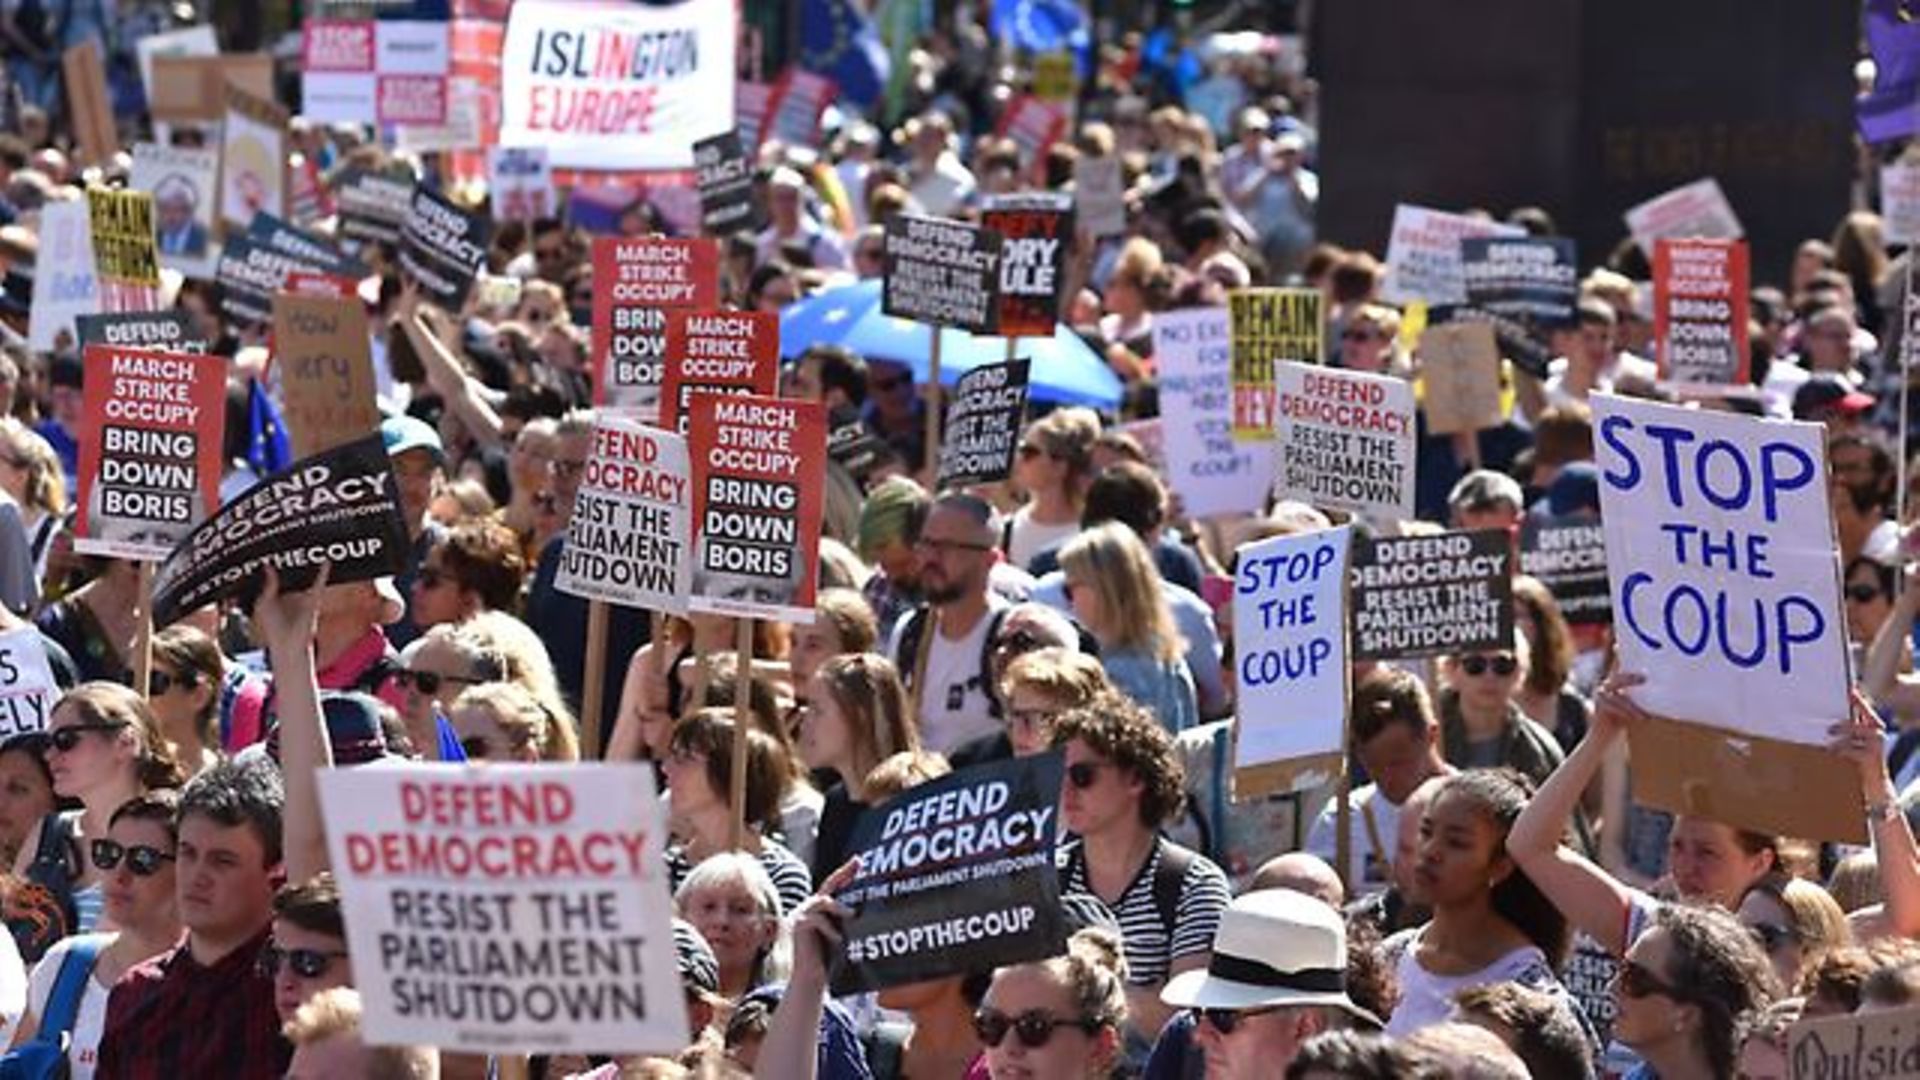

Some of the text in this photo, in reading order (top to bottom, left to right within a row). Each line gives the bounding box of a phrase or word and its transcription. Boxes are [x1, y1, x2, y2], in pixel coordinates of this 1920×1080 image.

[531, 29, 697, 80] ISLINGTON
[527, 85, 658, 134] EUROPE
[886, 236, 999, 270] DEMOCRACY
[907, 221, 975, 248] DEFEND
[613, 283, 696, 301] OCCUPY
[106, 321, 181, 342] DEFEND
[1230, 295, 1318, 336] REMAIN
[681, 357, 756, 378] OCCUPY
[1303, 374, 1385, 406] DEFEND
[105, 400, 200, 426] OCCUPY
[1281, 394, 1411, 434] DEMOCRACY
[105, 428, 196, 457] BRING
[595, 428, 658, 464] FEND
[1292, 424, 1397, 461] RESIST THE
[103, 460, 194, 489] DOWN
[708, 448, 801, 475] OCCUPY
[1285, 445, 1404, 483] PARLIAMENT
[1600, 415, 1815, 523] STOP
[586, 461, 687, 505] OCRACY
[708, 478, 796, 510] BRING
[1285, 468, 1401, 506] SHUTDOWN
[105, 492, 190, 520] BORIS
[192, 466, 331, 548] DEFEND
[627, 503, 671, 537] THE
[706, 511, 795, 543] DOWN
[708, 543, 789, 576] BORIS
[1375, 536, 1473, 563] DEFEND
[1660, 523, 1775, 579] THE
[1237, 544, 1336, 595] STOP
[1350, 554, 1506, 588] DEMOCRACY
[1258, 593, 1317, 632] THE
[1365, 580, 1490, 611] RESIST THE
[1356, 600, 1501, 631] PARLIAMENT
[1621, 572, 1827, 675] COUP
[1360, 621, 1500, 652] SHUTDOWN
[1242, 637, 1332, 687] COUP
[400, 781, 574, 827] DEFEND
[881, 781, 1009, 840] DEFEND
[345, 833, 649, 879] DEMOCRACY
[892, 867, 970, 896] PARLIAMENT
[972, 851, 1048, 881] SHUTDOWN
[389, 889, 621, 934] RESIST THE
[847, 906, 1035, 961] #STOPTHECOUP
[379, 934, 647, 979] PARLIAMENT
[390, 978, 648, 1024] SHUTDOWN
